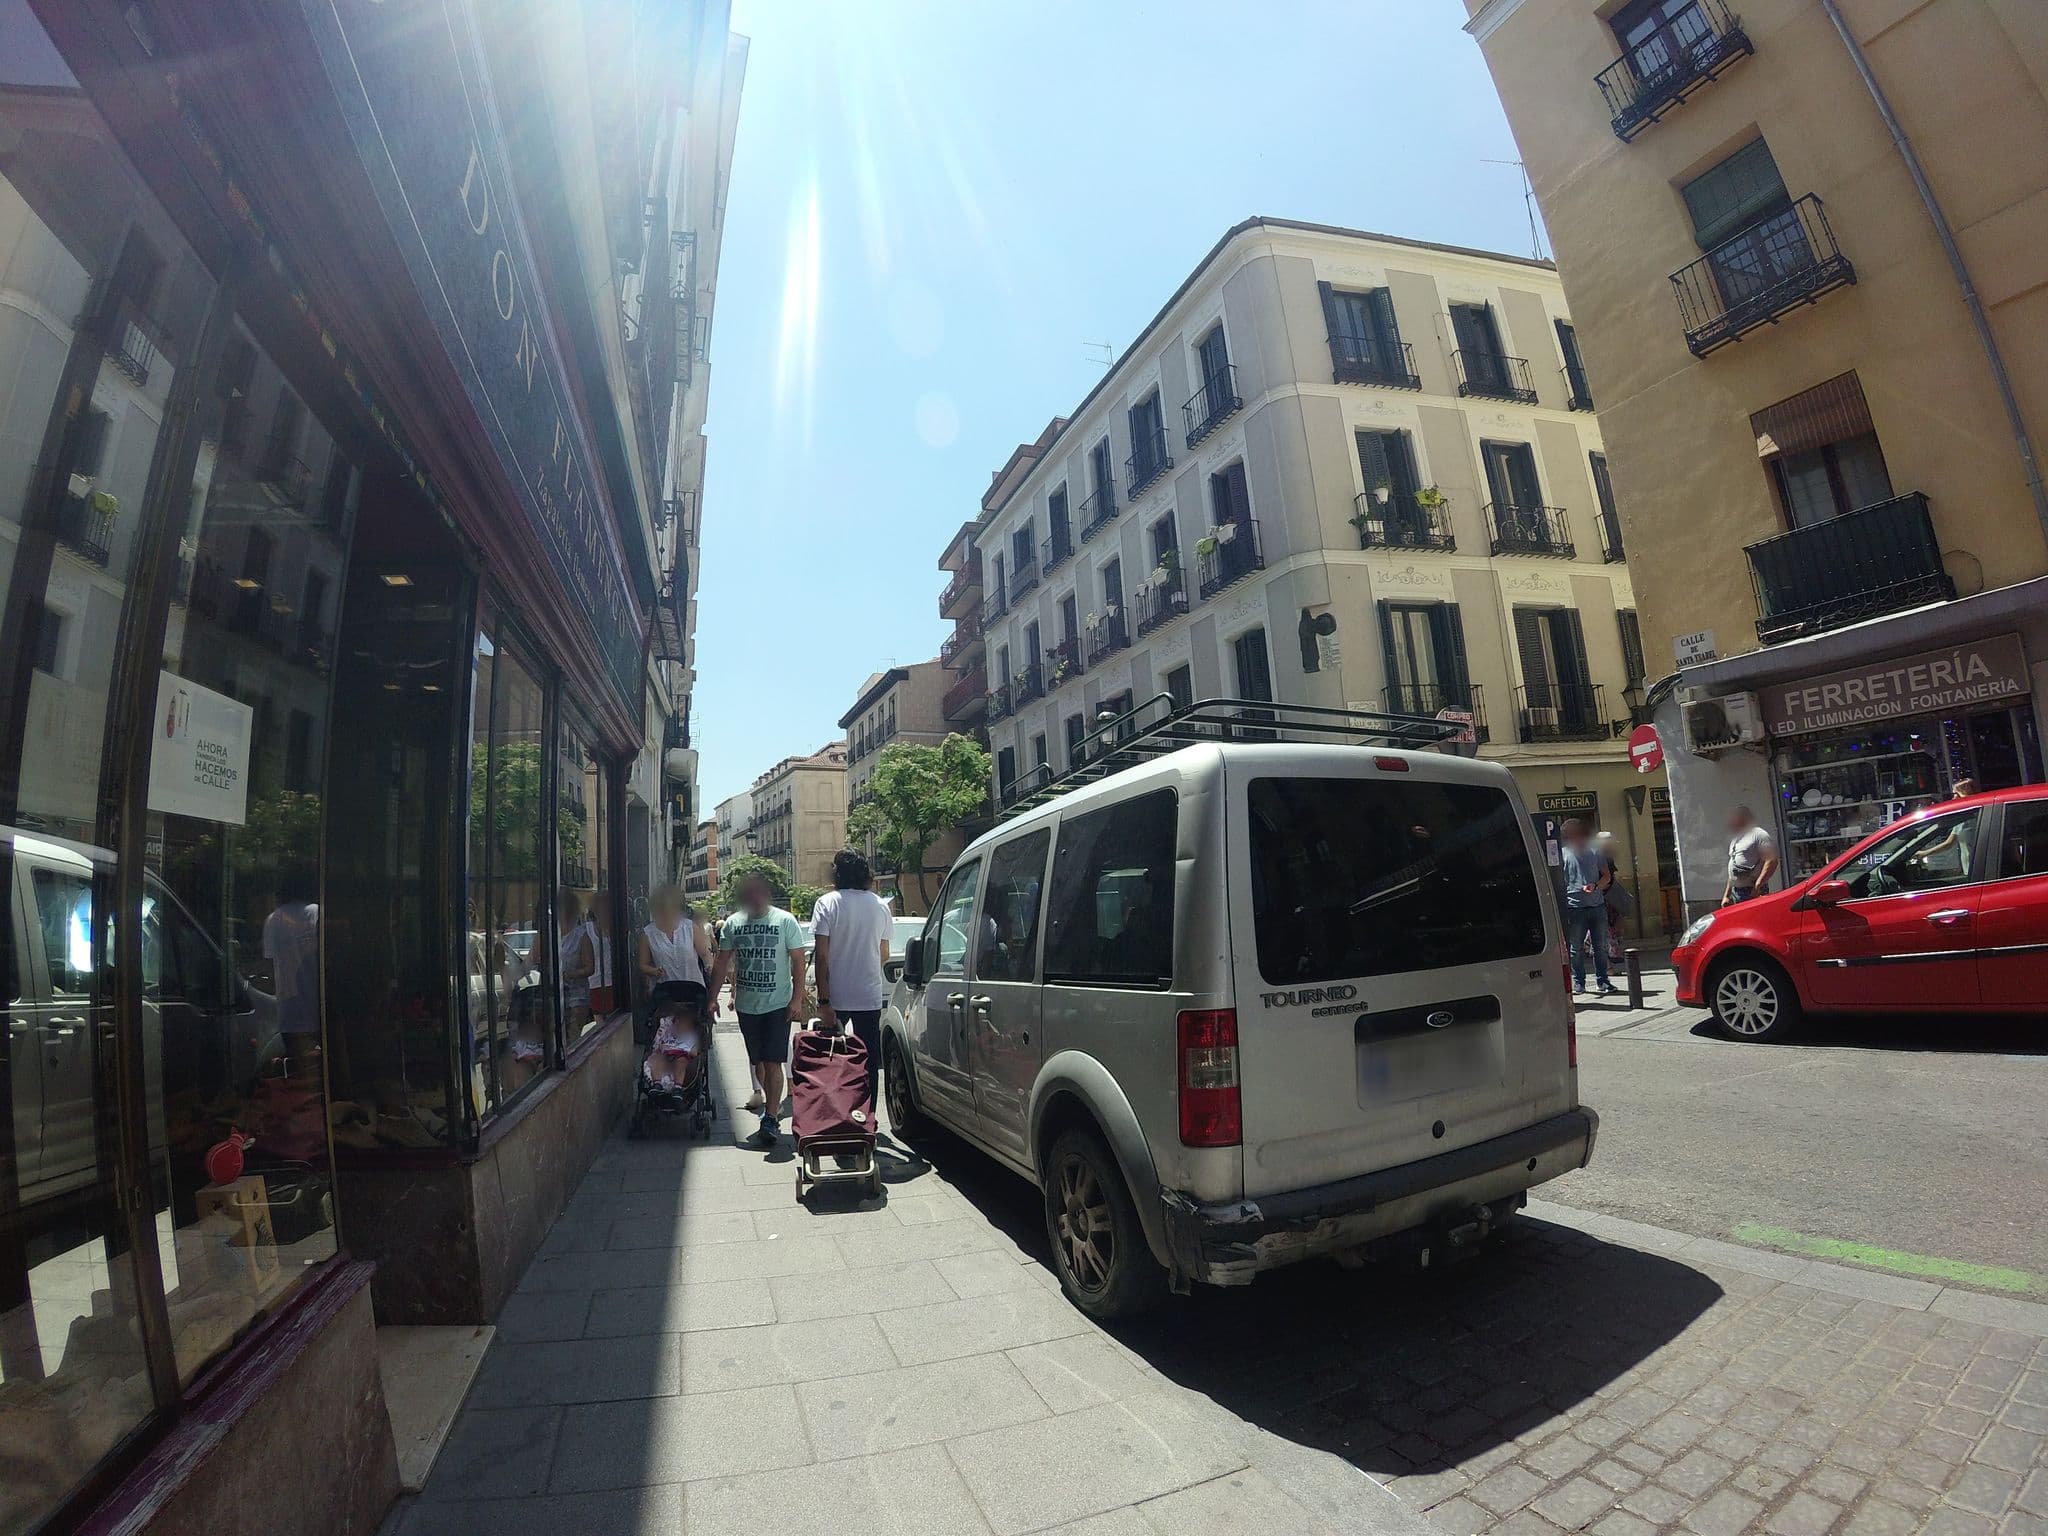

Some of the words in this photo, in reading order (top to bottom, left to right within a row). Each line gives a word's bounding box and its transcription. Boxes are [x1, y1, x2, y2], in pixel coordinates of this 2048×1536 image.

[459, 138, 538, 394] DON
[552, 415, 627, 639] FLAMENCO
[1680, 633, 1705, 647] CALLE
[1690, 645, 1699, 653] DE
[1784, 651, 1991, 716] FERRETERÍA
[1768, 719, 1797, 736] LED
[1803, 700, 1902, 730] ILUMINACIÓN
[1910, 677, 2020, 711] FONTANERÍA
[197, 739, 228, 759] AHORA
[194, 760, 238, 781] HACEMOS
[201, 774, 230, 790] CALLE
[1543, 797, 1591, 809] CAFETERÍA
[1653, 792, 1664, 802] EL
[1545, 820, 1554, 836] P
[734, 924, 780, 936] WELCOME
[1259, 984, 1358, 1009] TOURNEO
